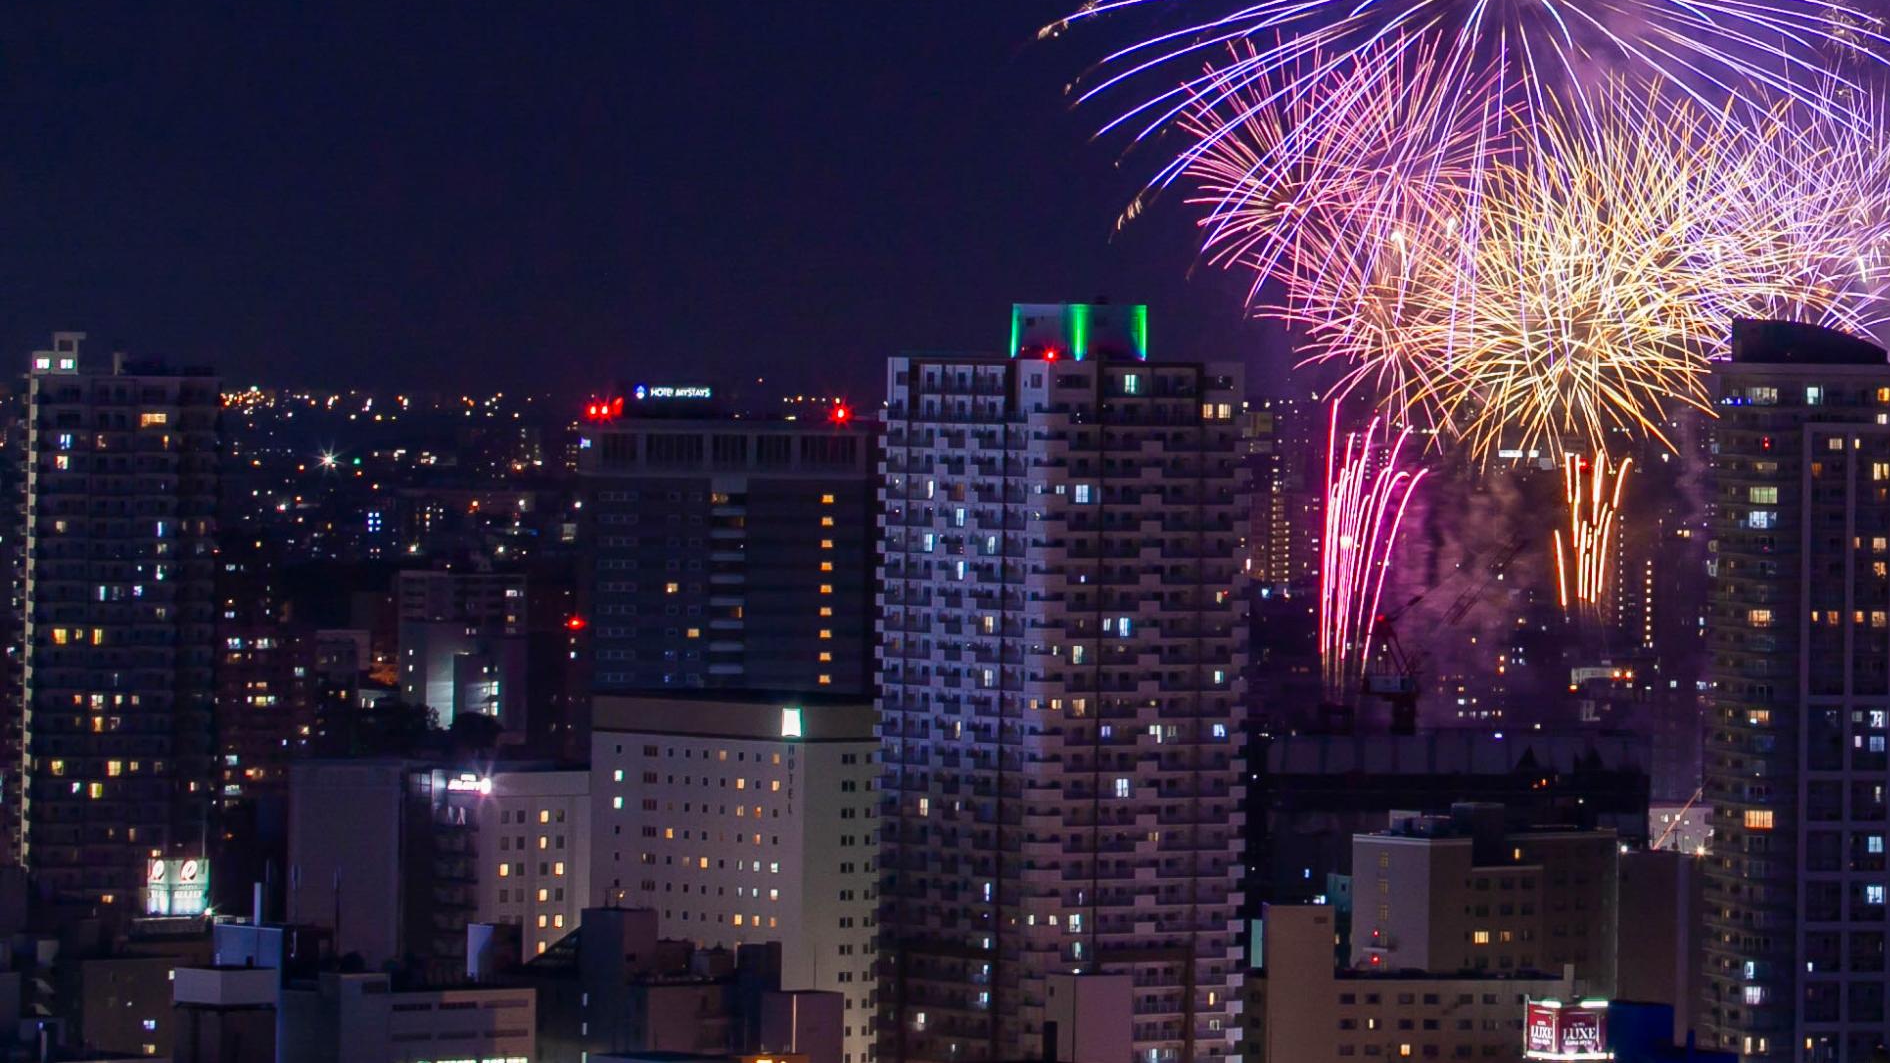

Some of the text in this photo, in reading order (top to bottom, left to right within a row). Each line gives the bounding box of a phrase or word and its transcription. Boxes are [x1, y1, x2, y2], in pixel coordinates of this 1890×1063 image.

[787, 744, 795, 814] HOTEL
[1530, 1024, 1553, 1039] LUXE
[1563, 1026, 1596, 1040] LUXE
